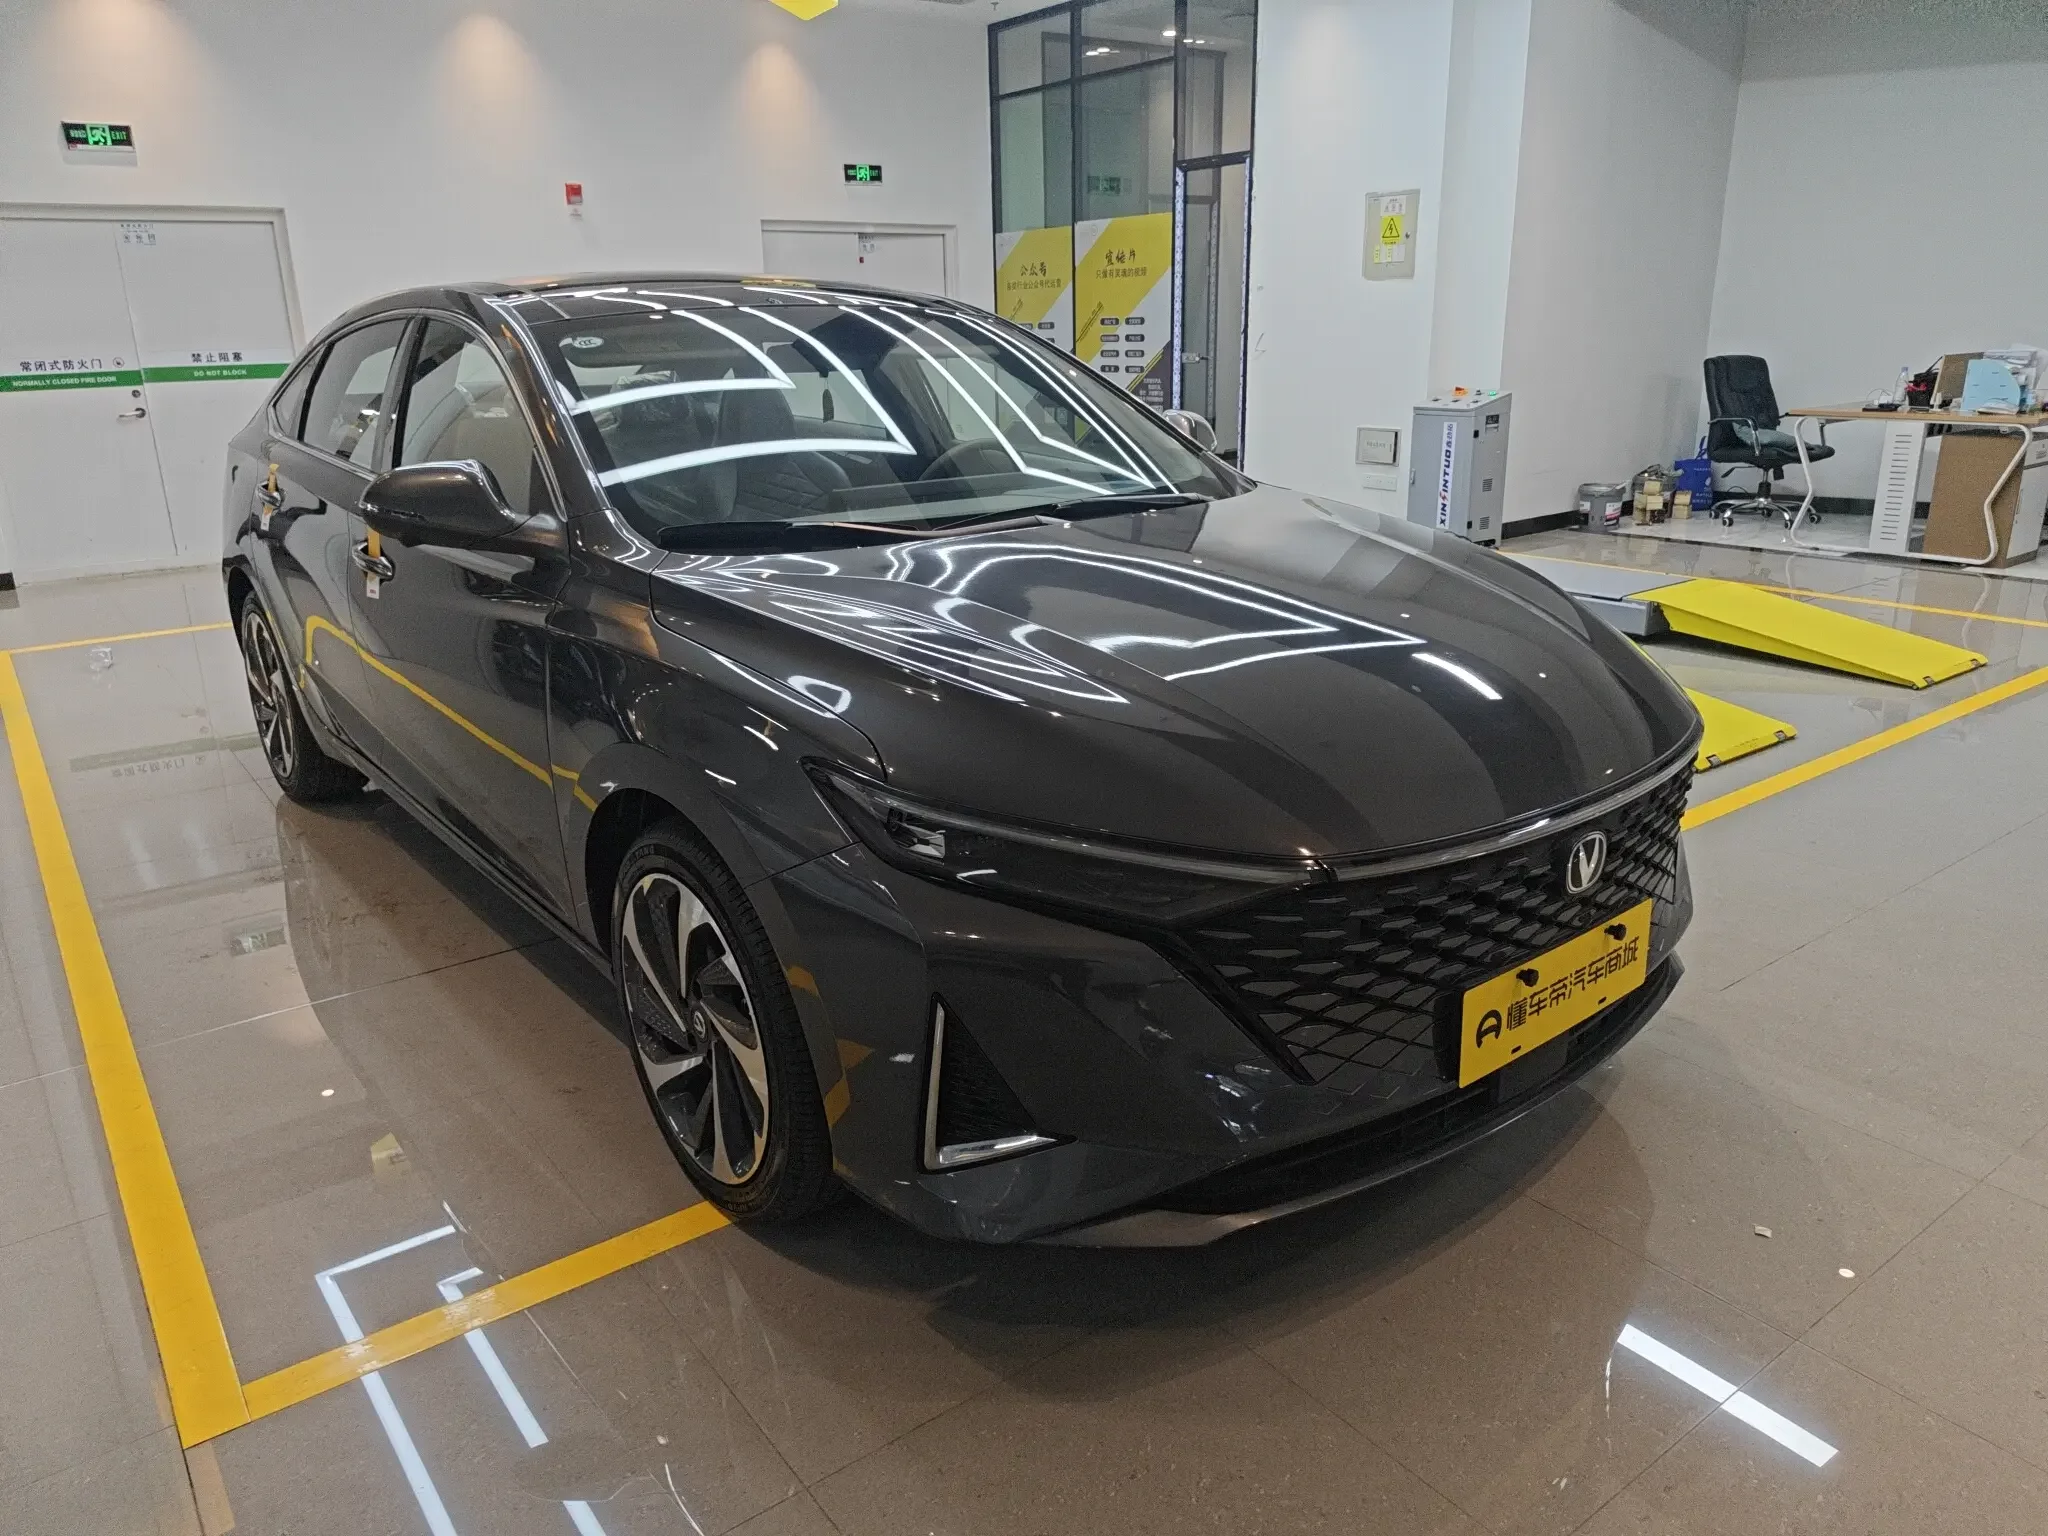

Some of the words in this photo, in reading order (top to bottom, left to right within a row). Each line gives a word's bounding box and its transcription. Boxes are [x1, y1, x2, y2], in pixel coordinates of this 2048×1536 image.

[1020, 260, 1047, 277] 公众号
[191, 351, 243, 363] 禁止阻塞
[19, 358, 103, 373] 常闭式防火门
[12, 379, 51, 388] NORMALLY
[52, 377, 80, 386] CLOSED
[80, 376, 97, 384] FIRE
[97, 375, 118, 383] DOOR
[1506, 935, 1640, 1031] 懂车帝汽车商城
